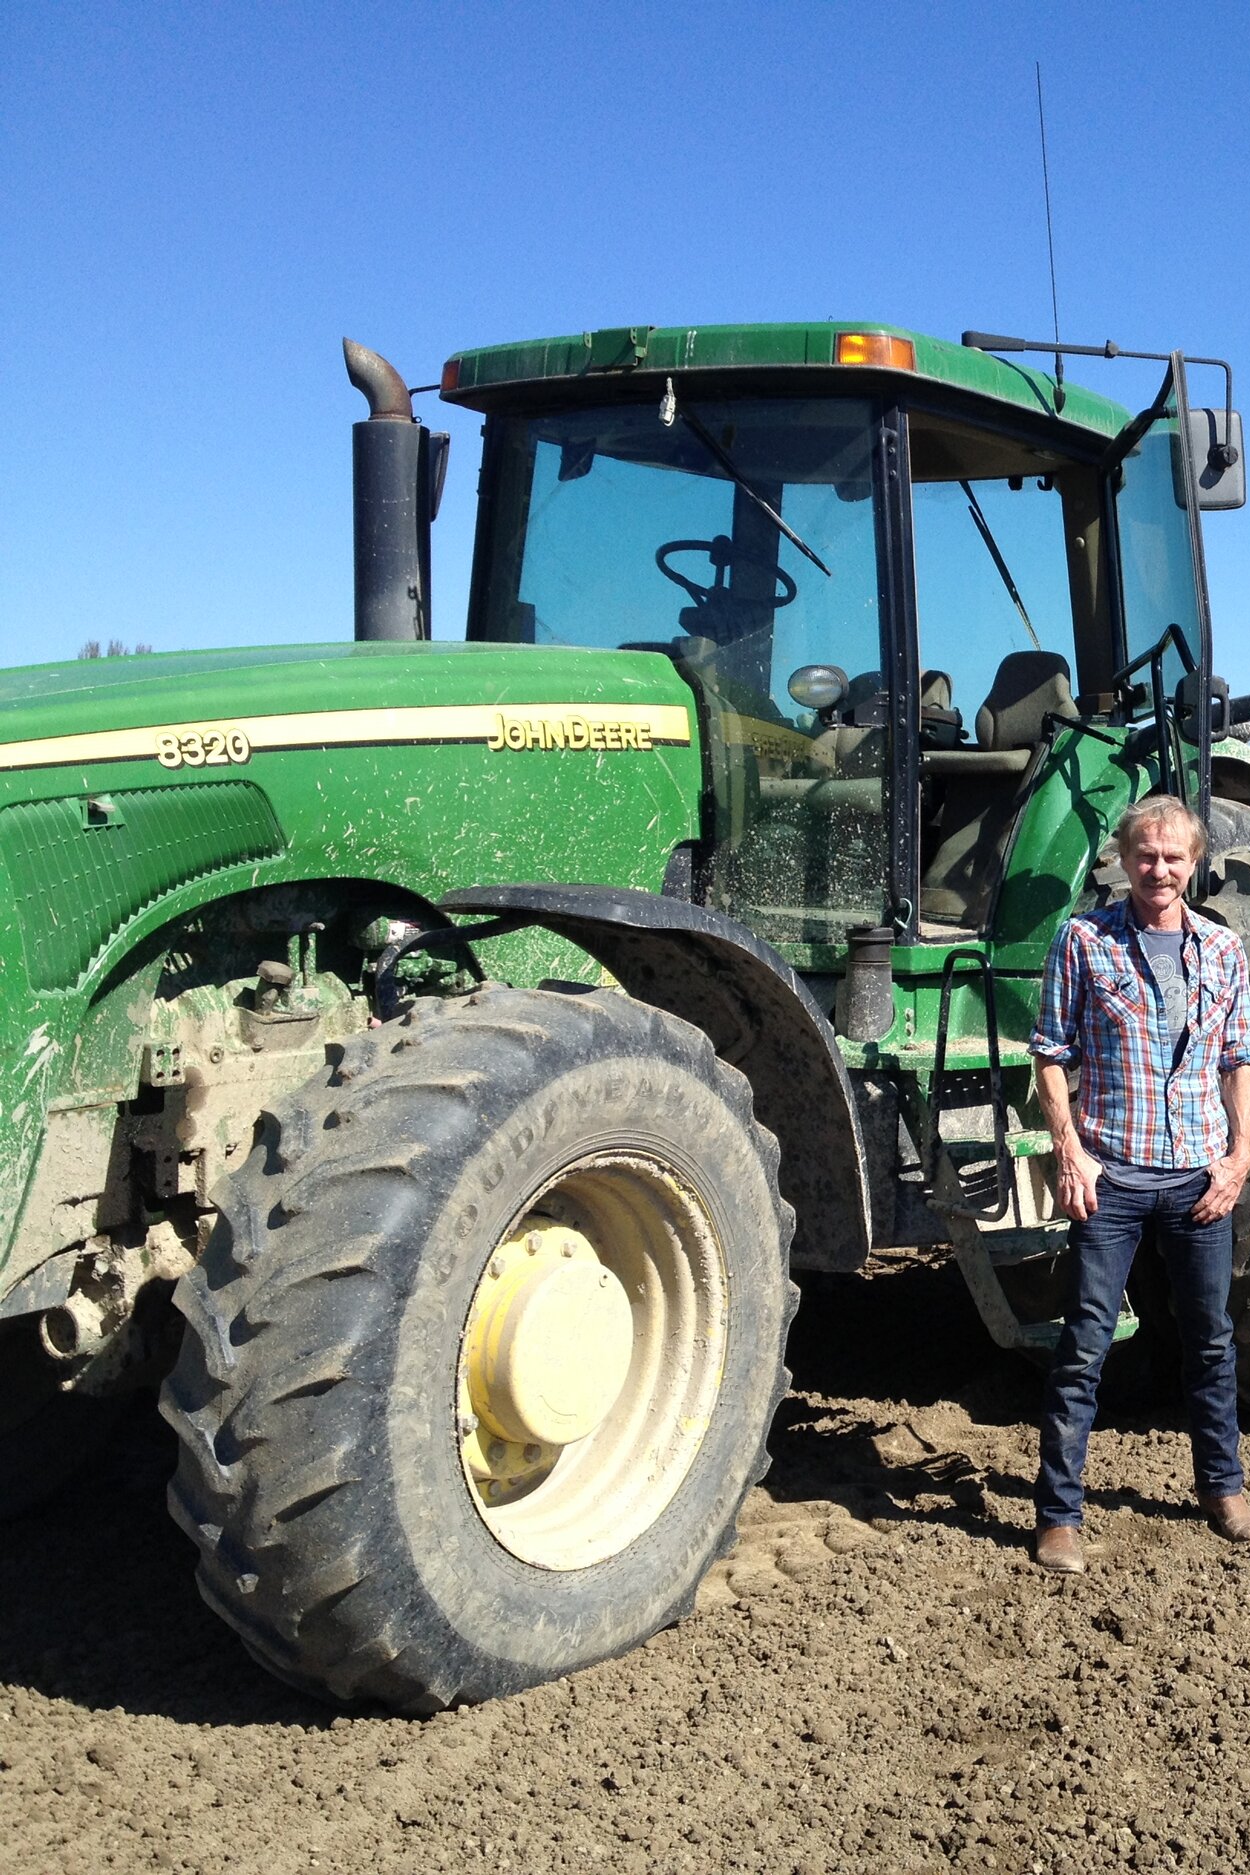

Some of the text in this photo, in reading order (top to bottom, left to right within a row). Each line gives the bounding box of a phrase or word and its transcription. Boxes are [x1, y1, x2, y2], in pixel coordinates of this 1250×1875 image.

[155, 728, 251, 770] 8320
[487, 713, 652, 752] JOHN DEERE
